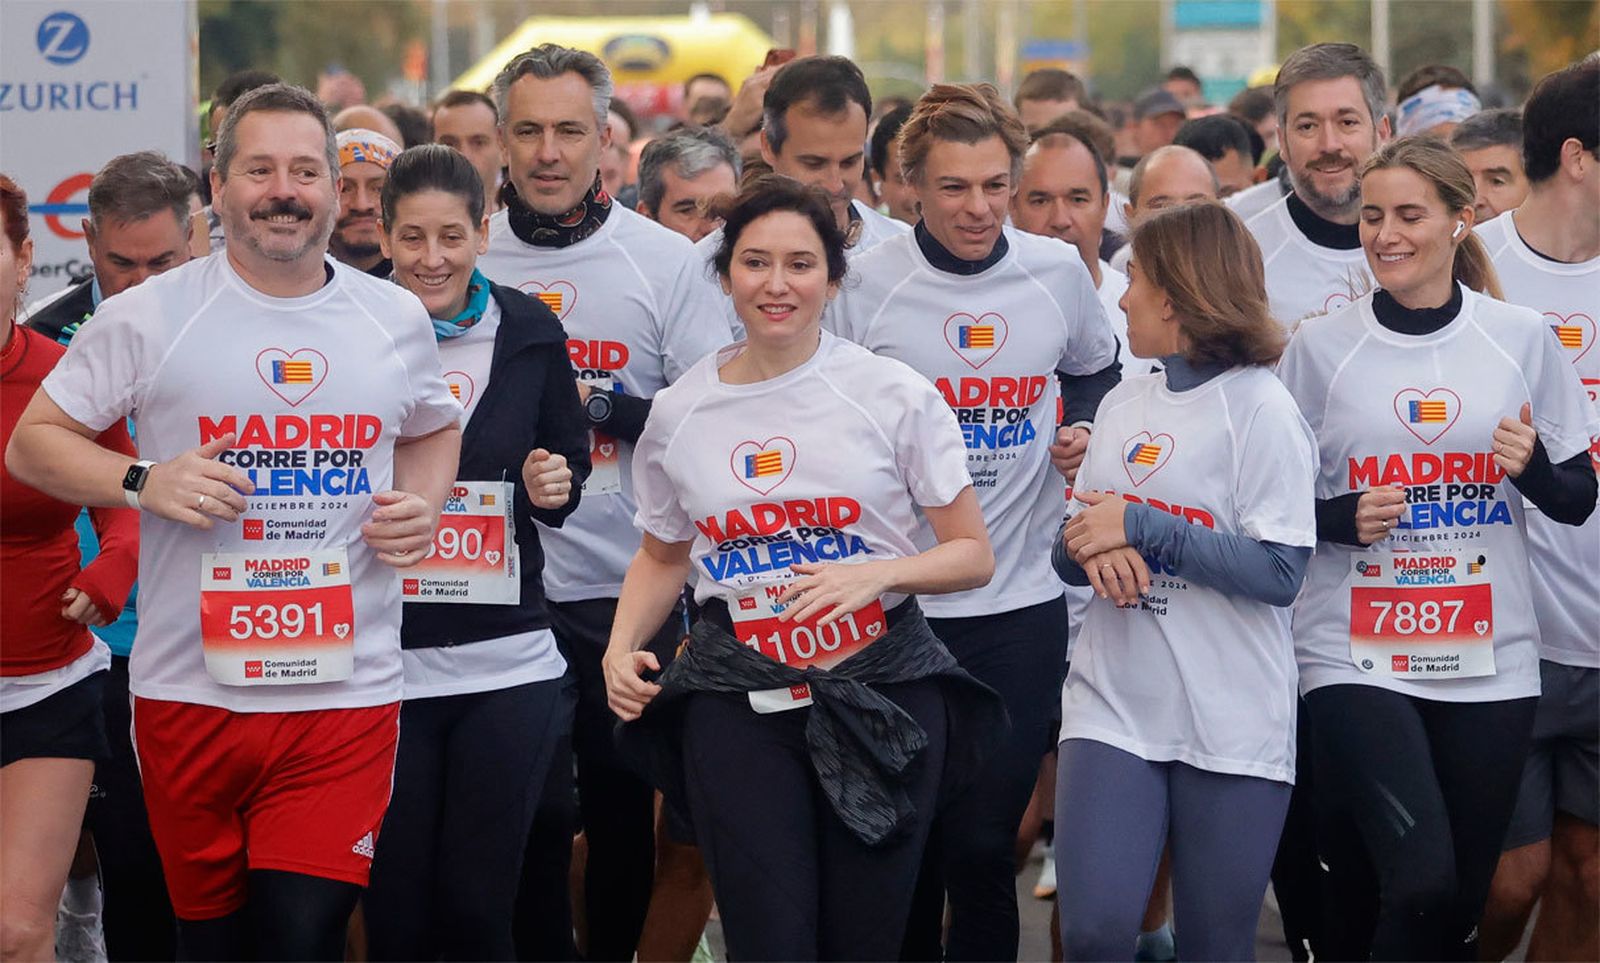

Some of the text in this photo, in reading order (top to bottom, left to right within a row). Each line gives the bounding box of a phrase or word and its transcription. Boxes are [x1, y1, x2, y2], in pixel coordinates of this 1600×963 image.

[0, 81, 138, 111] ZURICH
[565, 338, 629, 371] RID
[935, 375, 1047, 408] ADRID
[991, 408, 1030, 424] POR
[198, 414, 383, 450] MADRID
[960, 419, 1036, 450] ENCIA
[218, 450, 364, 469] CORRE POR
[969, 469, 999, 478] unidad
[1349, 452, 1507, 491] MADRID
[232, 467, 372, 497] LENCIA
[1446, 484, 1496, 501] POR
[250, 501, 349, 511] ICIEMBRE 2024
[695, 496, 861, 545] MADRID
[1397, 500, 1513, 530] LENCIA
[266, 519, 327, 529] Comunidad
[266, 530, 326, 540] de Madrid
[716, 530, 793, 553] CORRE
[1454, 531, 1481, 540] 2024
[245, 557, 311, 572] MADRID
[701, 534, 874, 582] VALENCIA
[1394, 556, 1457, 570] MADRID
[252, 570, 304, 579] CORRE POR
[1401, 567, 1450, 576] CORRE POR
[246, 576, 311, 588] VALENCIA
[420, 579, 469, 588] Comunidad
[1161, 580, 1188, 590] 2024
[1395, 574, 1457, 586] VALENCIA
[435, 588, 469, 597] Madrid
[229, 602, 324, 640] 5391
[1369, 600, 1465, 635] 7887
[264, 659, 318, 669] Comunidad
[1410, 655, 1460, 664] Comunidad
[264, 669, 318, 679] de Madrid
[1410, 664, 1460, 673] de Madrid
[352, 845, 375, 860] adida
